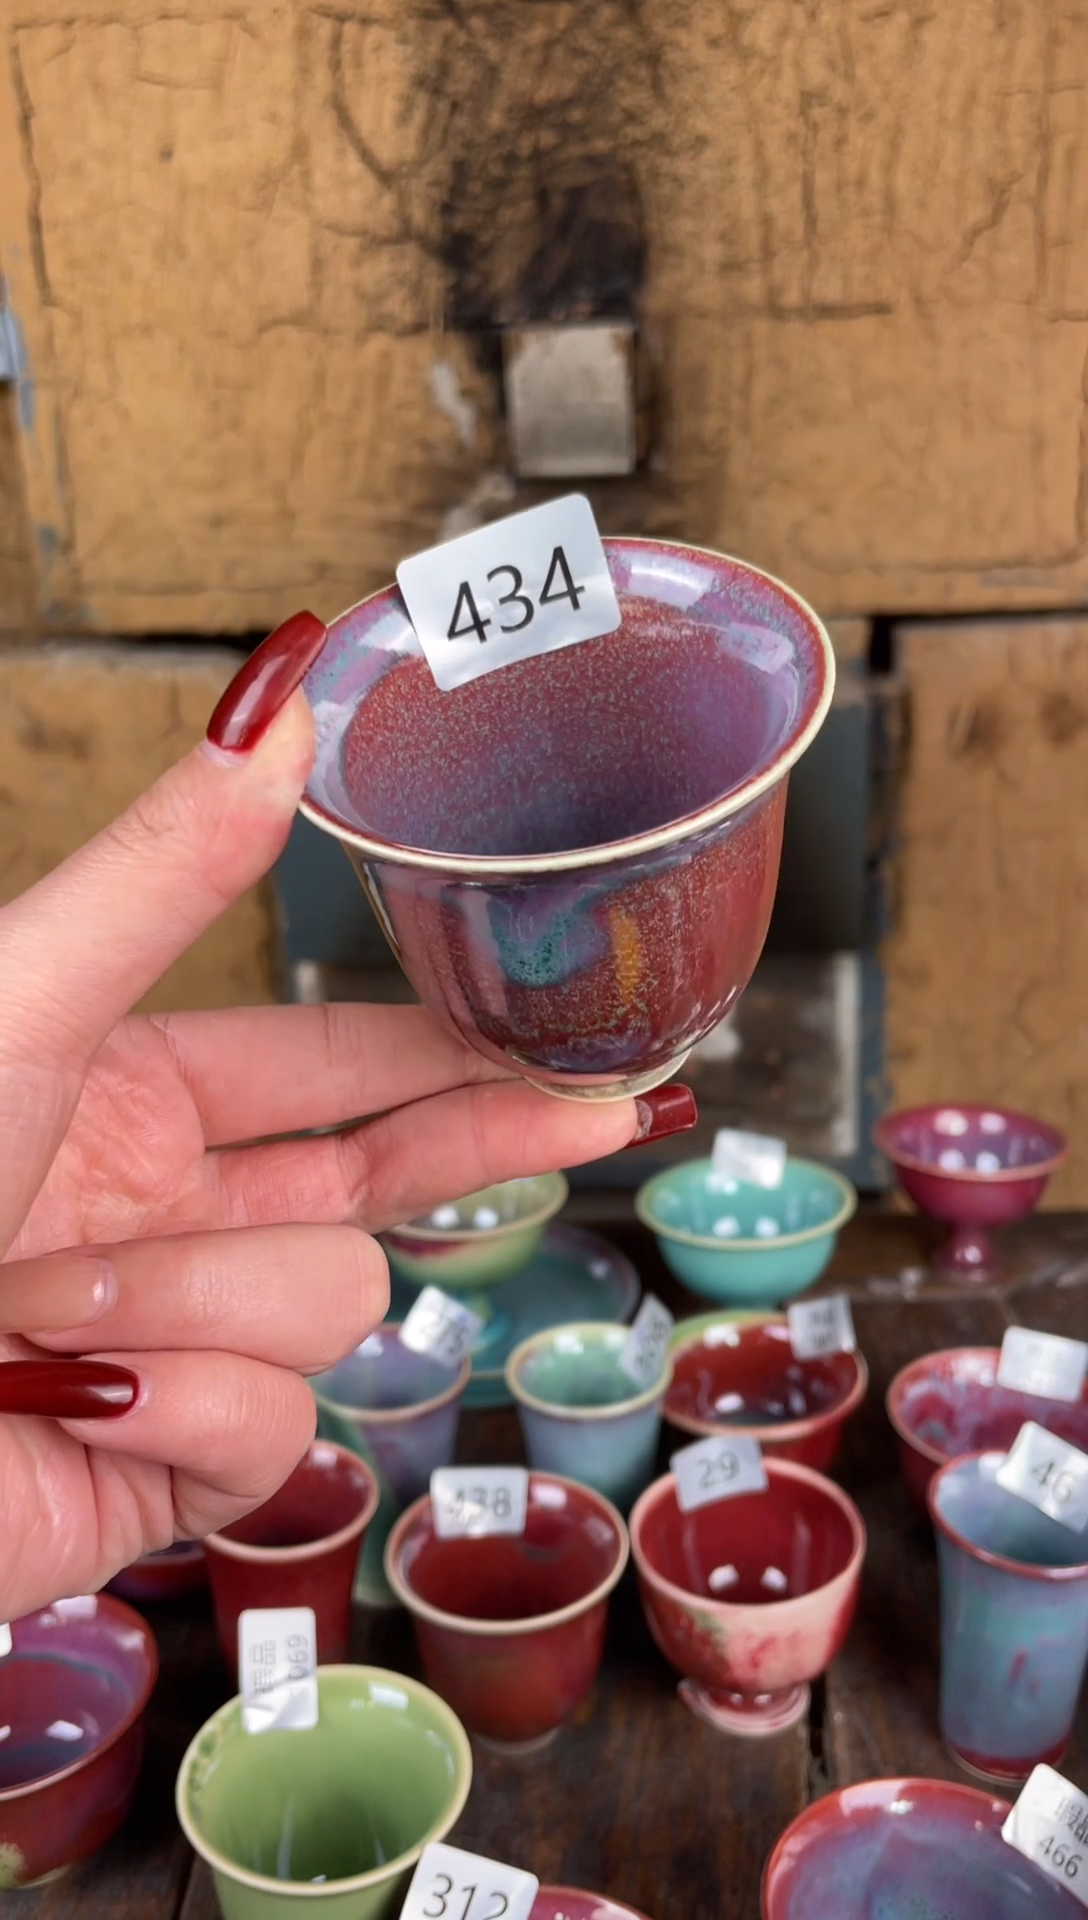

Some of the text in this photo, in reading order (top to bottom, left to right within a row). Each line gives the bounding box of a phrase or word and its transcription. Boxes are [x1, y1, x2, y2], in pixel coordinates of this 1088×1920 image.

[447, 545, 586, 644] 434
[694, 1449, 741, 1490] 29
[1030, 1459, 1073, 1503] 46
[1038, 1835, 1085, 1880] 466
[422, 1871, 509, 1920] 312
